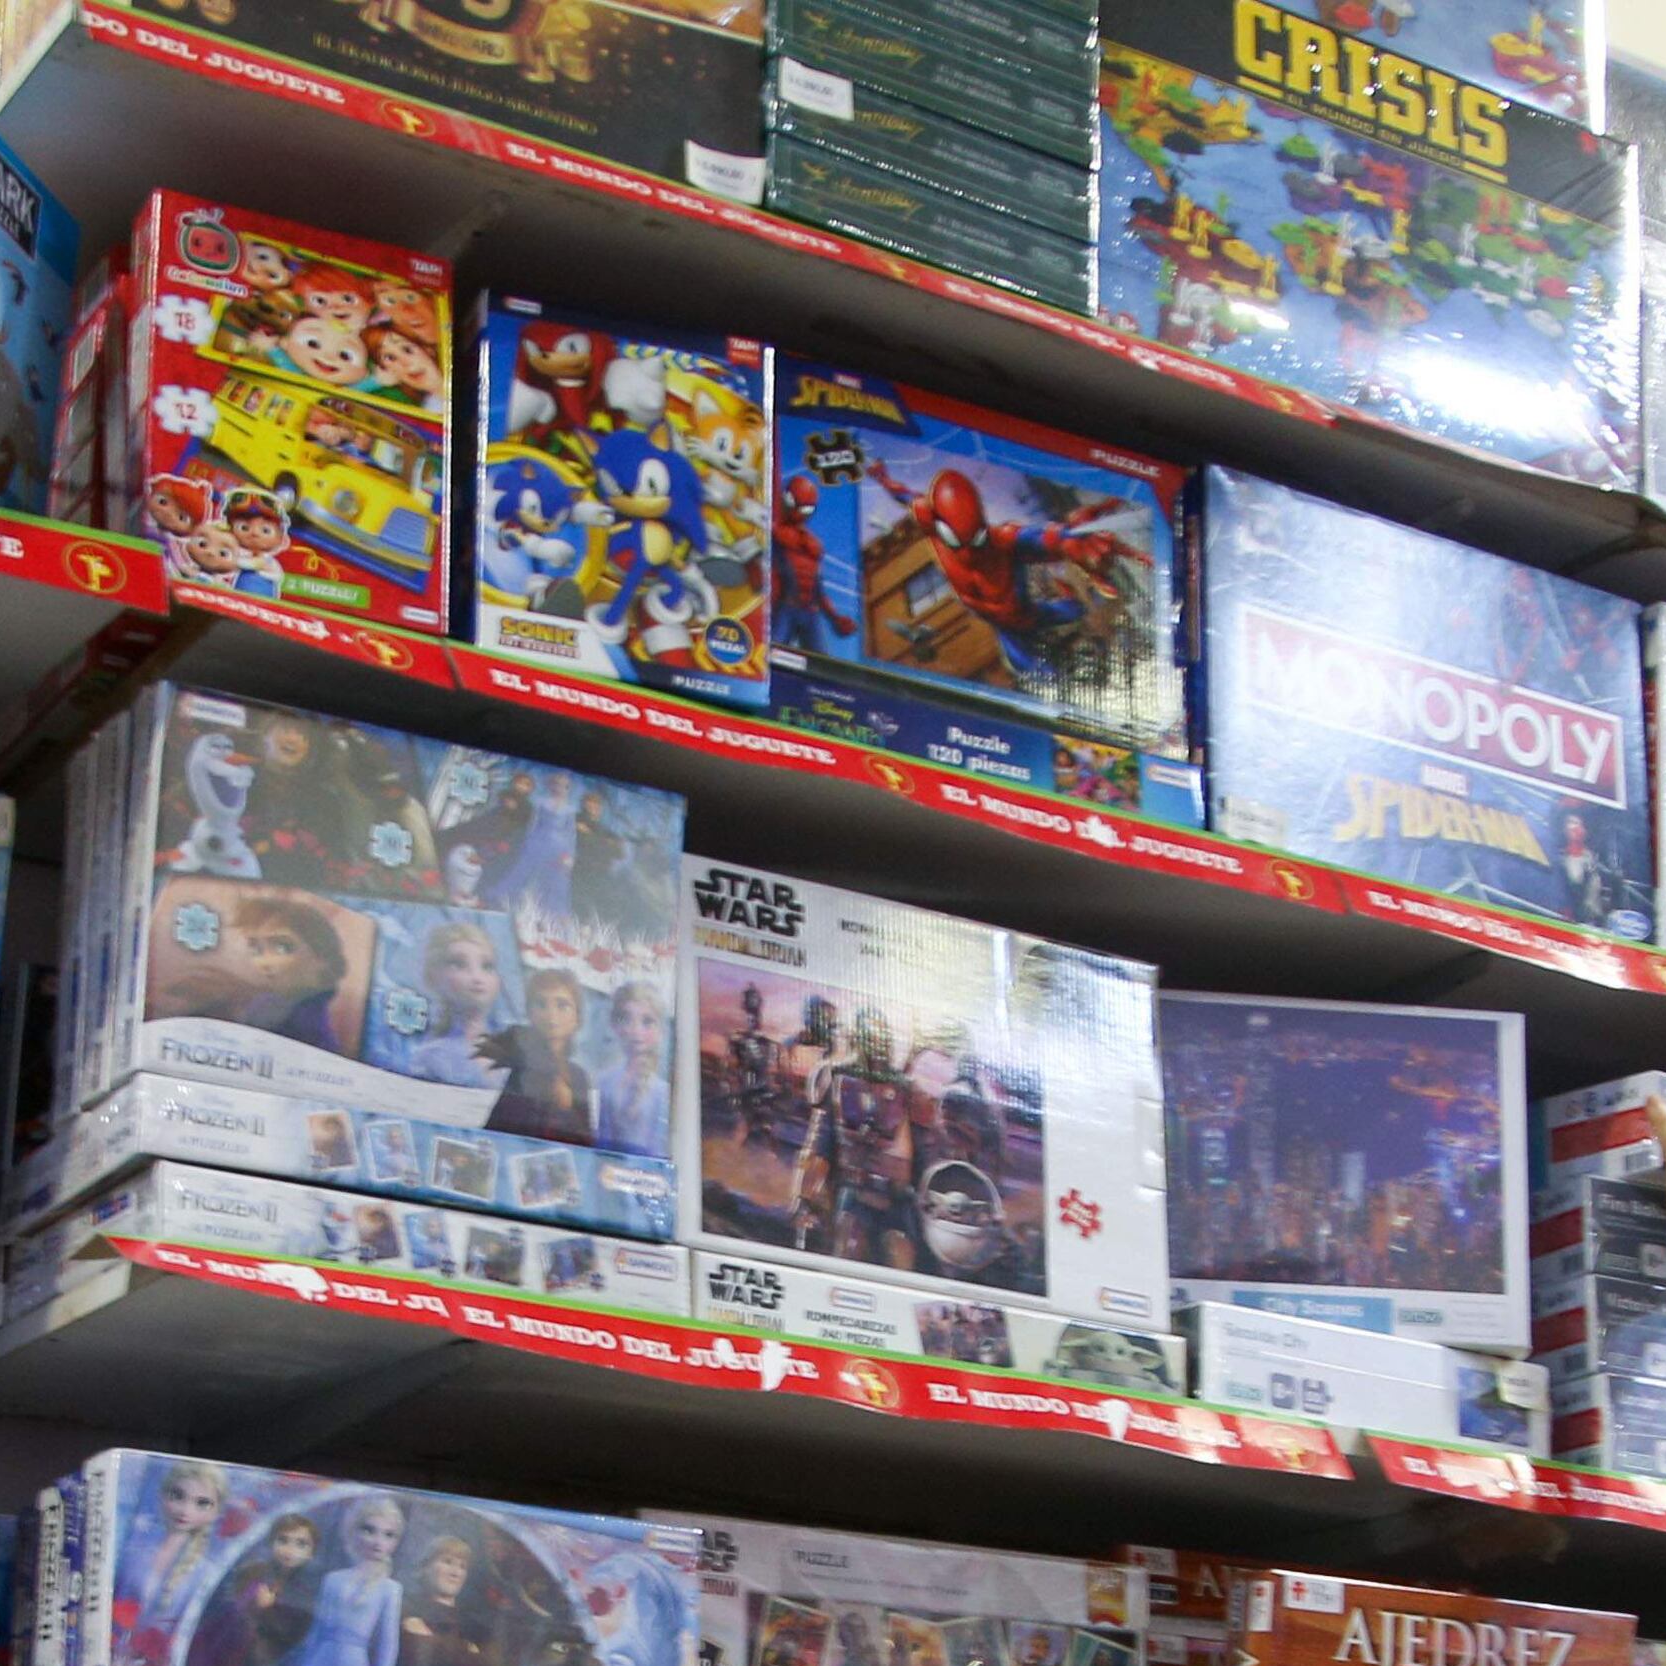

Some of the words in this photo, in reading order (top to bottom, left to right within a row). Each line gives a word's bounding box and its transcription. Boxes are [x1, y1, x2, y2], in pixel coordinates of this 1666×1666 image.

[137, 27, 197, 61] DEL
[205, 51, 344, 103] JUGUETE
[1236, 0, 1510, 168] CRISIS
[499, 618, 579, 650] SONIC
[672, 673, 732, 696] PUZZLE
[492, 670, 531, 692] EL
[538, 682, 641, 721] MUNDO
[650, 709, 702, 738] DEL
[709, 725, 837, 767] JUGUETE
[1252, 630, 1613, 784] MONOPOLY
[949, 726, 1011, 755] Puzzle
[969, 752, 1031, 782] piezas
[942, 784, 975, 806] EL
[980, 794, 1071, 833] MUNDO
[1130, 836, 1242, 875] JUGUETE
[695, 869, 803, 909] STAR
[694, 899, 803, 936] WARS
[161, 1037, 254, 1075] FROZEN
[157, 1250, 202, 1271] EL
[334, 1281, 399, 1306] DEL
[708, 1264, 782, 1286] STAR
[708, 1282, 785, 1309] WARS
[462, 1306, 503, 1328] EL
[511, 1312, 615, 1349] MUNDO
[624, 1334, 680, 1364] DEL
[926, 1383, 967, 1404] EL
[970, 1389, 1070, 1414] MUNDO
